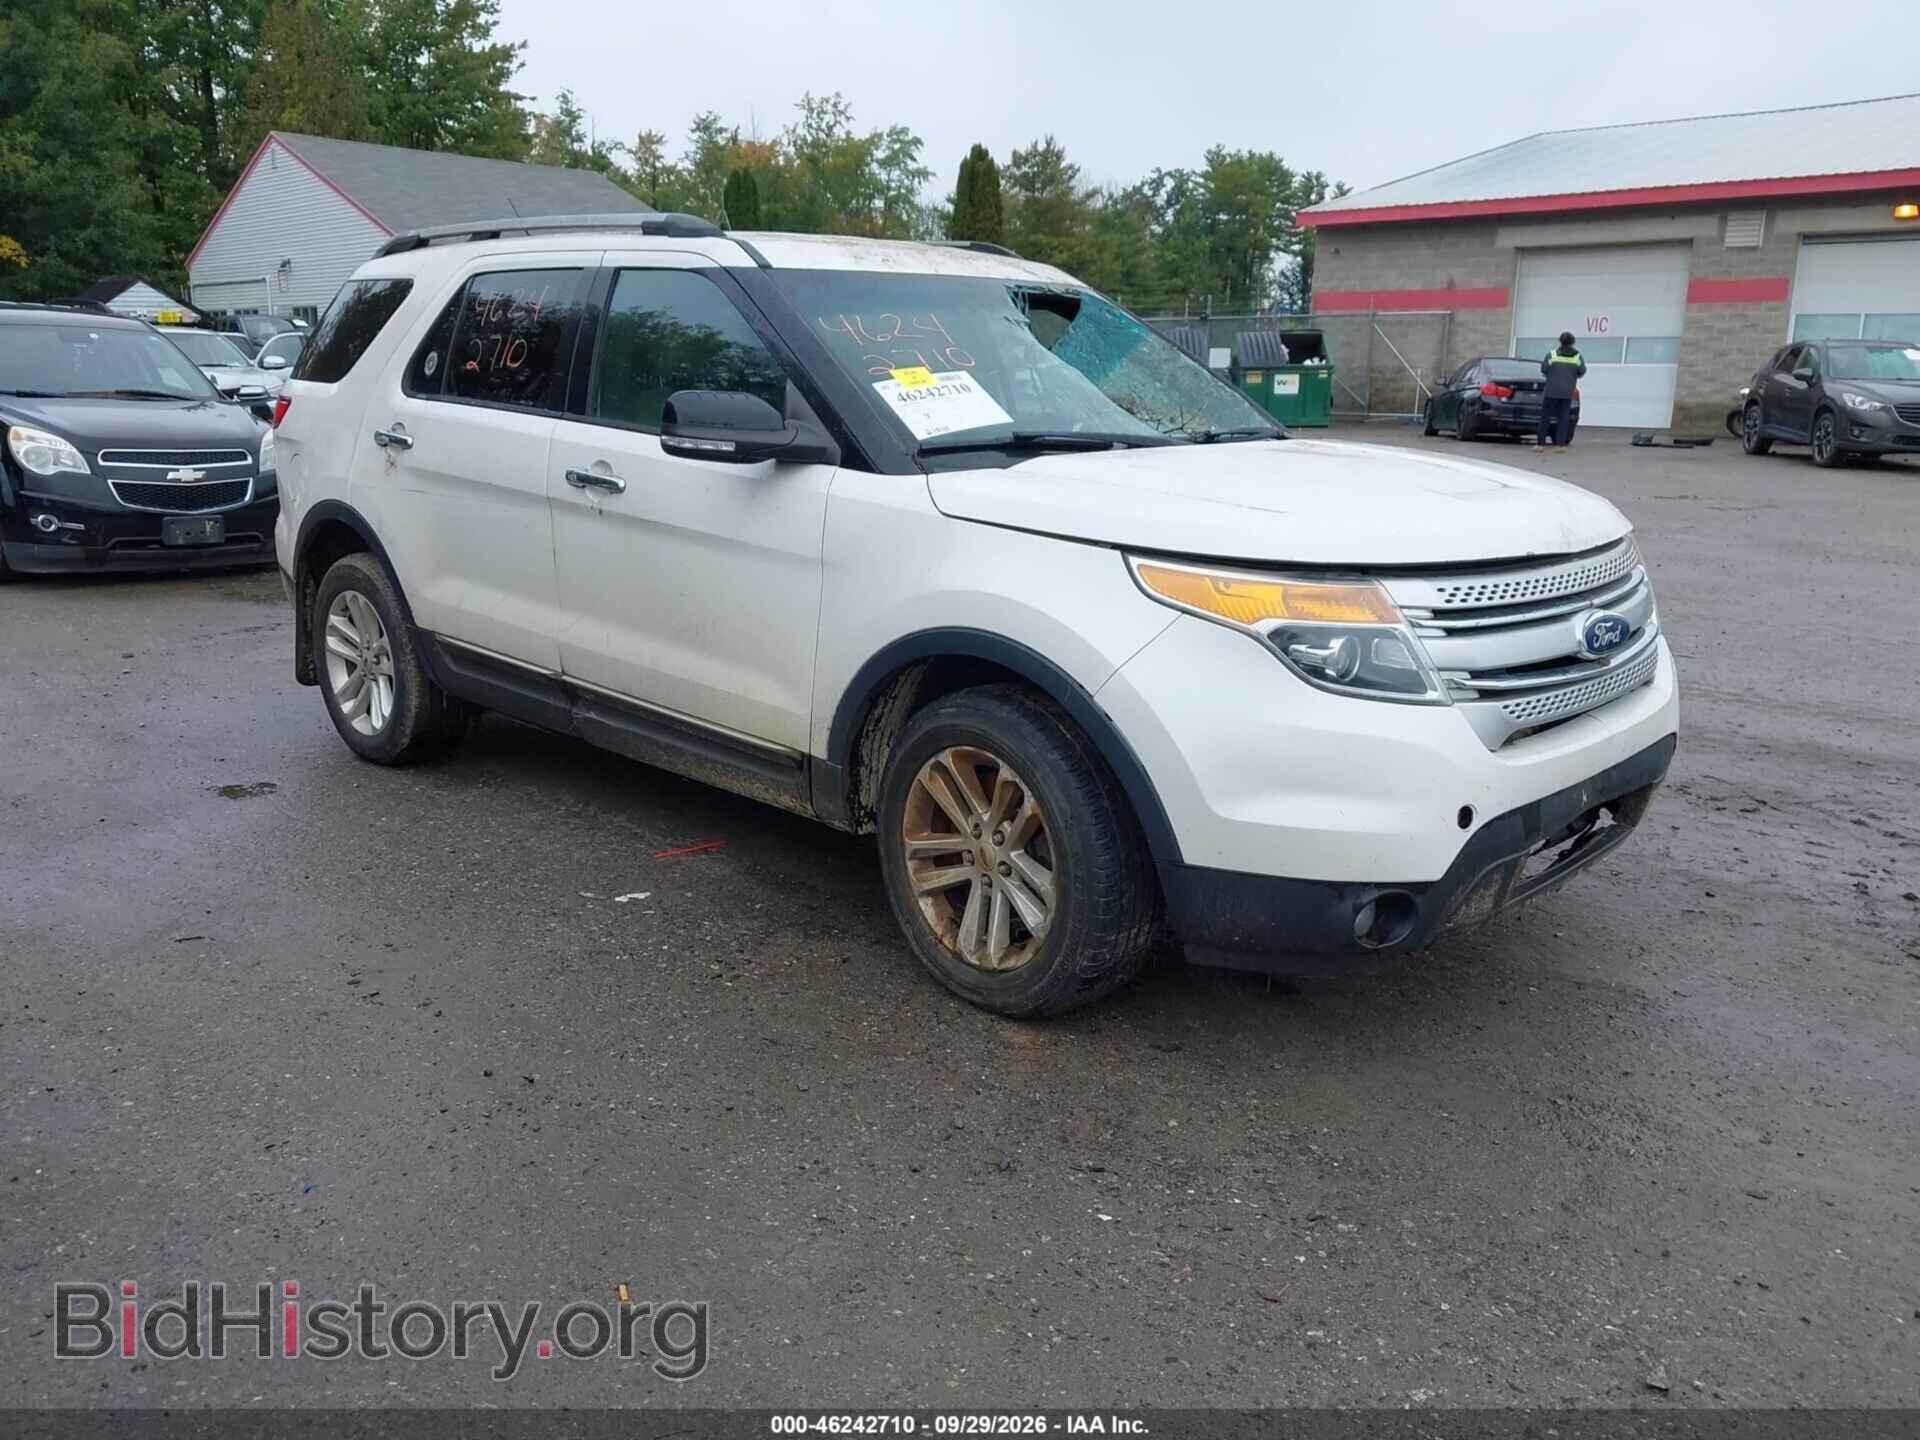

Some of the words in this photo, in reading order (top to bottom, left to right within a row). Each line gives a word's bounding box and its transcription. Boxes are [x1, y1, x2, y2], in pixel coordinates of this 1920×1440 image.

[475, 284, 549, 327] 4624
[818, 313, 955, 346] 4624
[1586, 316, 1609, 333] VIC
[465, 333, 528, 373] 2710
[897, 383, 972, 403] 46242710
[1593, 621, 1622, 648] Ford
